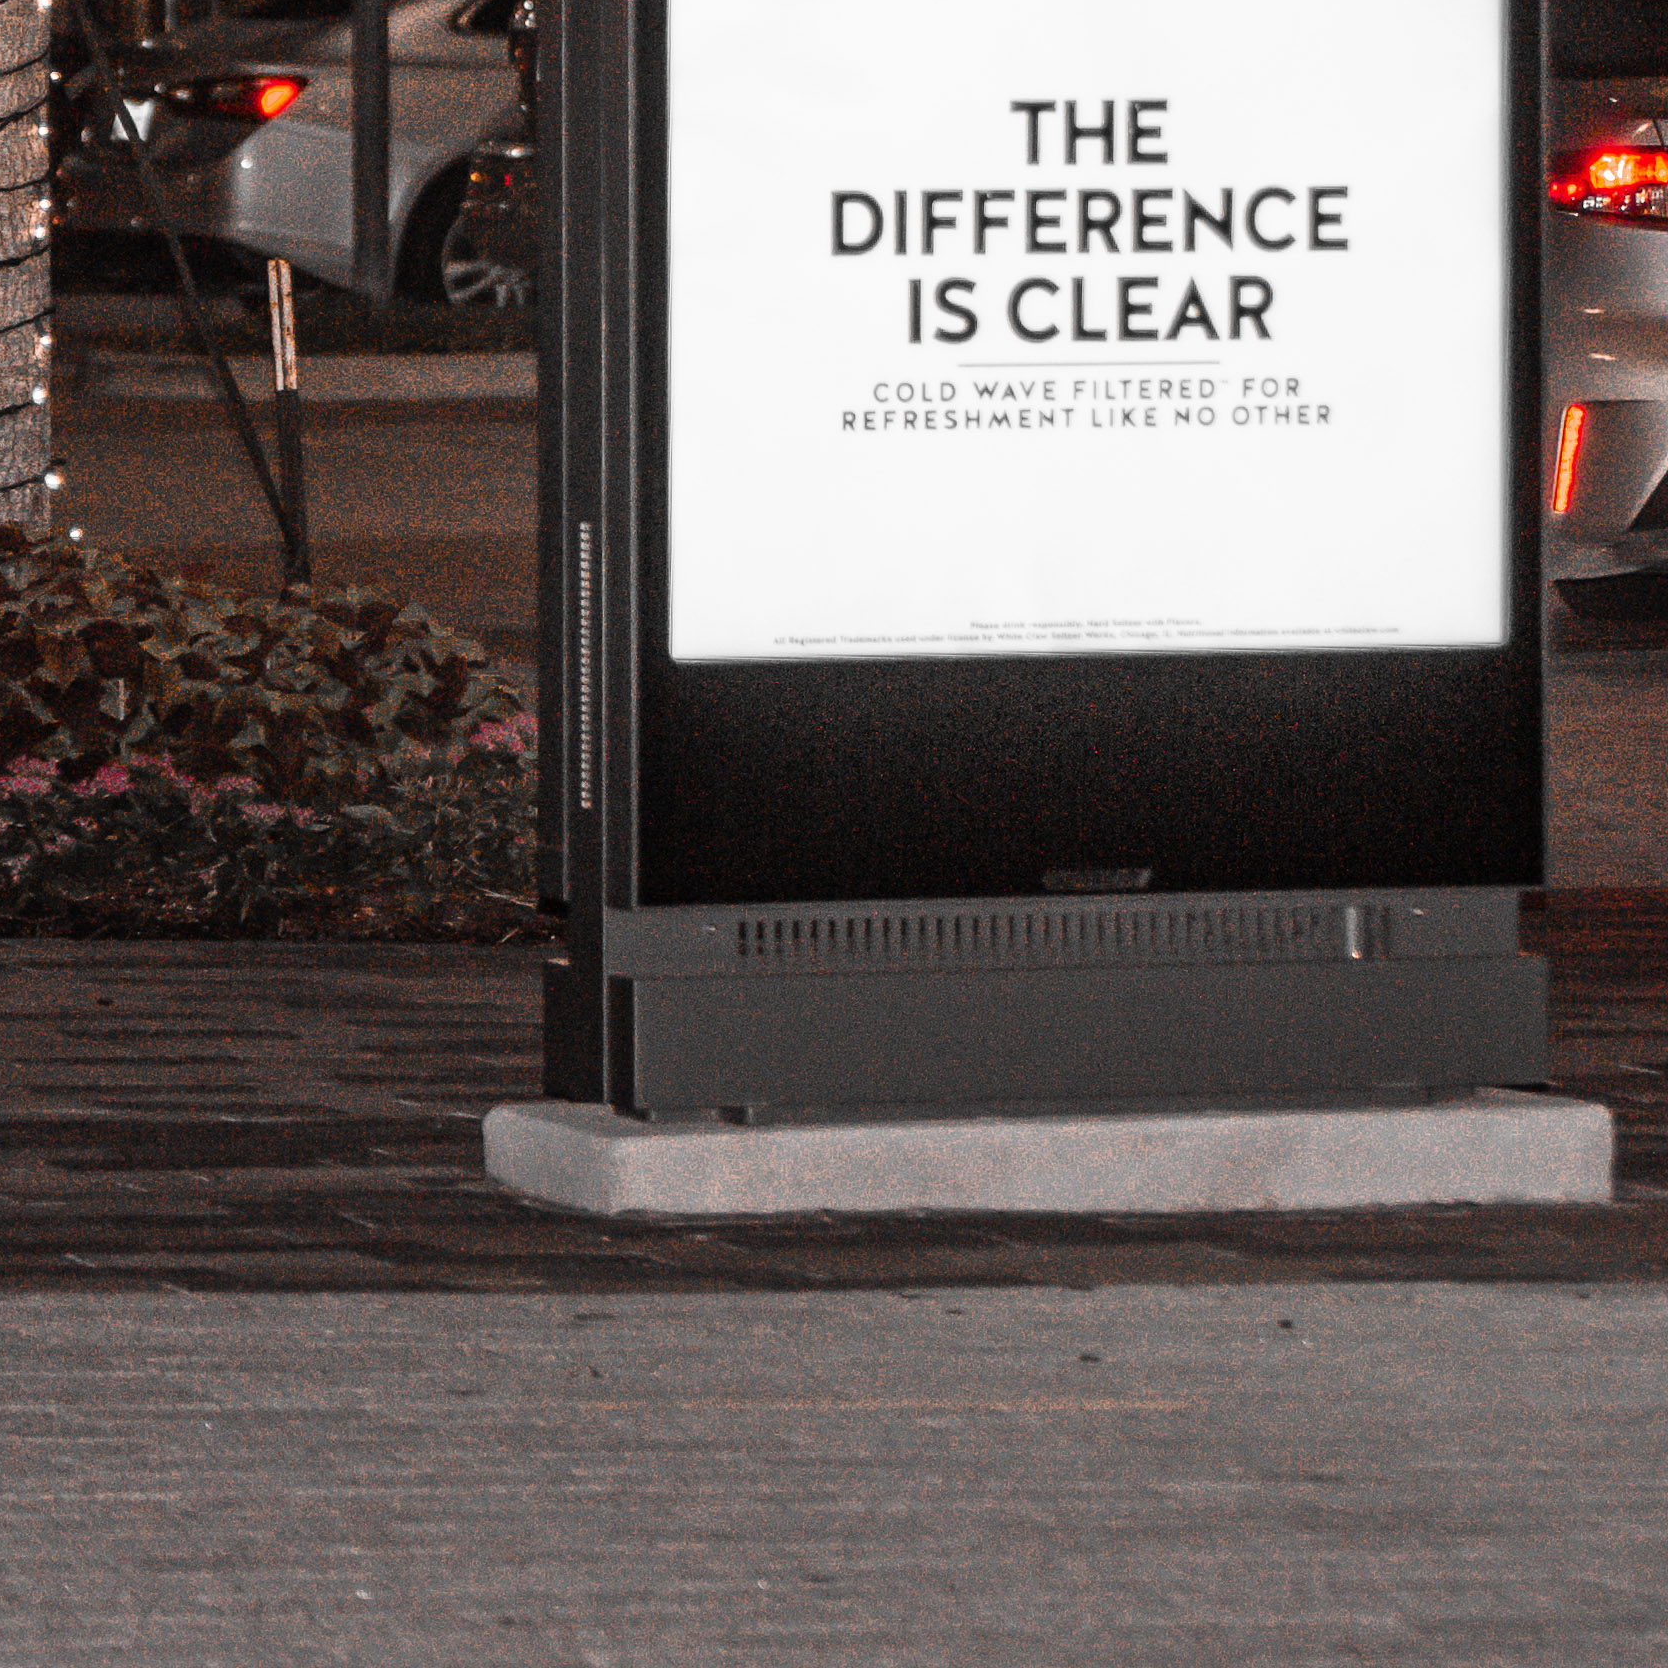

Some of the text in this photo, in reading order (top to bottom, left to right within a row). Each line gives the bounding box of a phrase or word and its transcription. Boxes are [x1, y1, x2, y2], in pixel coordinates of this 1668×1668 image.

[1012, 100, 1167, 164] THE
[833, 187, 1348, 255] DIFFERENCE
[910, 276, 1273, 343] IS CLEAR
[843, 405, 1330, 430] REFRESHMENT LIKE NO OTHER
[873, 382, 956, 403] COLD
[974, 381, 1055, 400] WAVE
[1243, 378, 1299, 397] FOR
